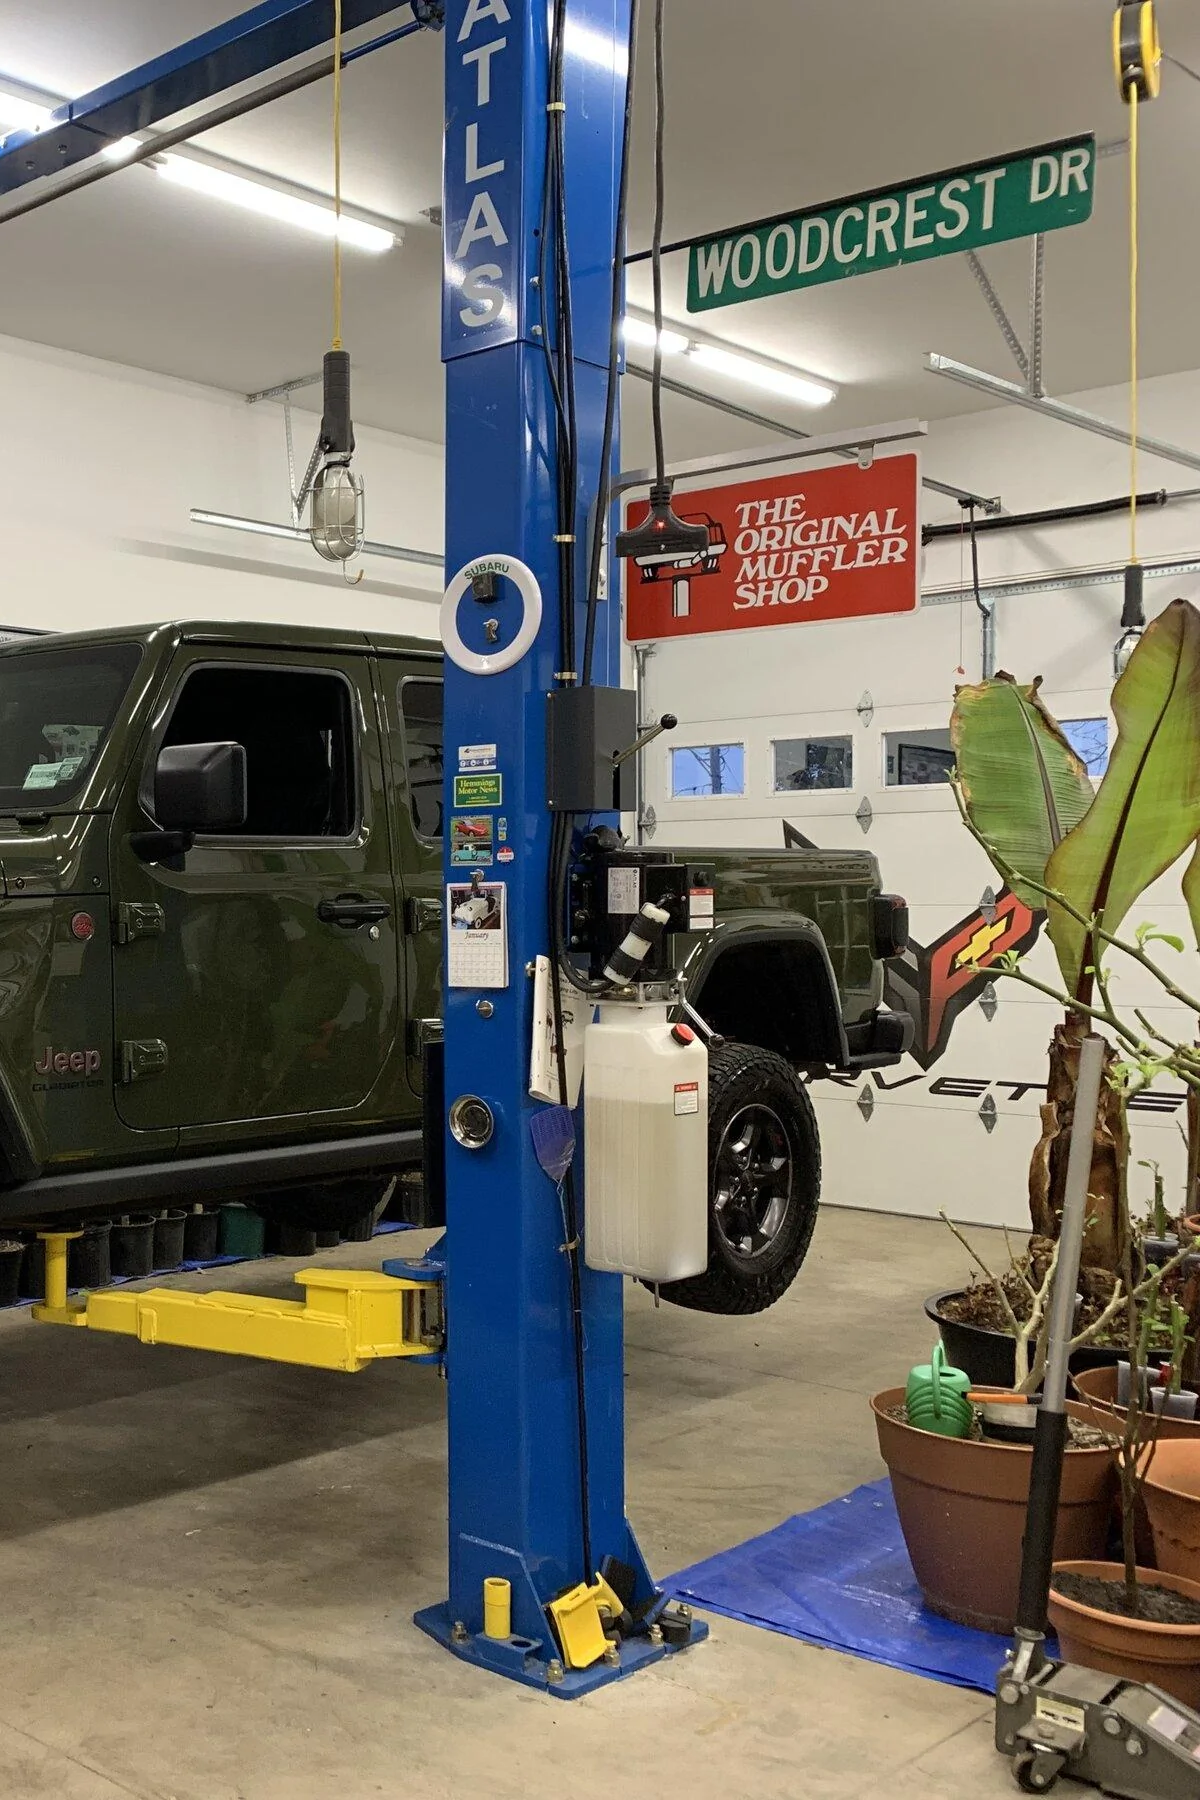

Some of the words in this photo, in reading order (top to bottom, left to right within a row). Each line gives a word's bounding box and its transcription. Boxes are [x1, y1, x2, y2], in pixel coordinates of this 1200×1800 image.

[455, 0, 512, 328] ATLAS
[696, 167, 1007, 299] WOODCREST
[1029, 147, 1091, 204] DR
[734, 493, 806, 529] THE
[734, 507, 907, 556] ORIGINAL
[464, 561, 510, 580] SUBARU
[734, 537, 909, 583] MUFFLER
[733, 575, 829, 611] SHOP
[458, 787, 478, 795] Motor
[480, 786, 498, 794] News
[460, 779, 496, 788] Hemmings
[464, 931, 490, 941] January
[35, 1046, 102, 1077] Jeep
[32, 1079, 105, 1092] GLADIATOR
